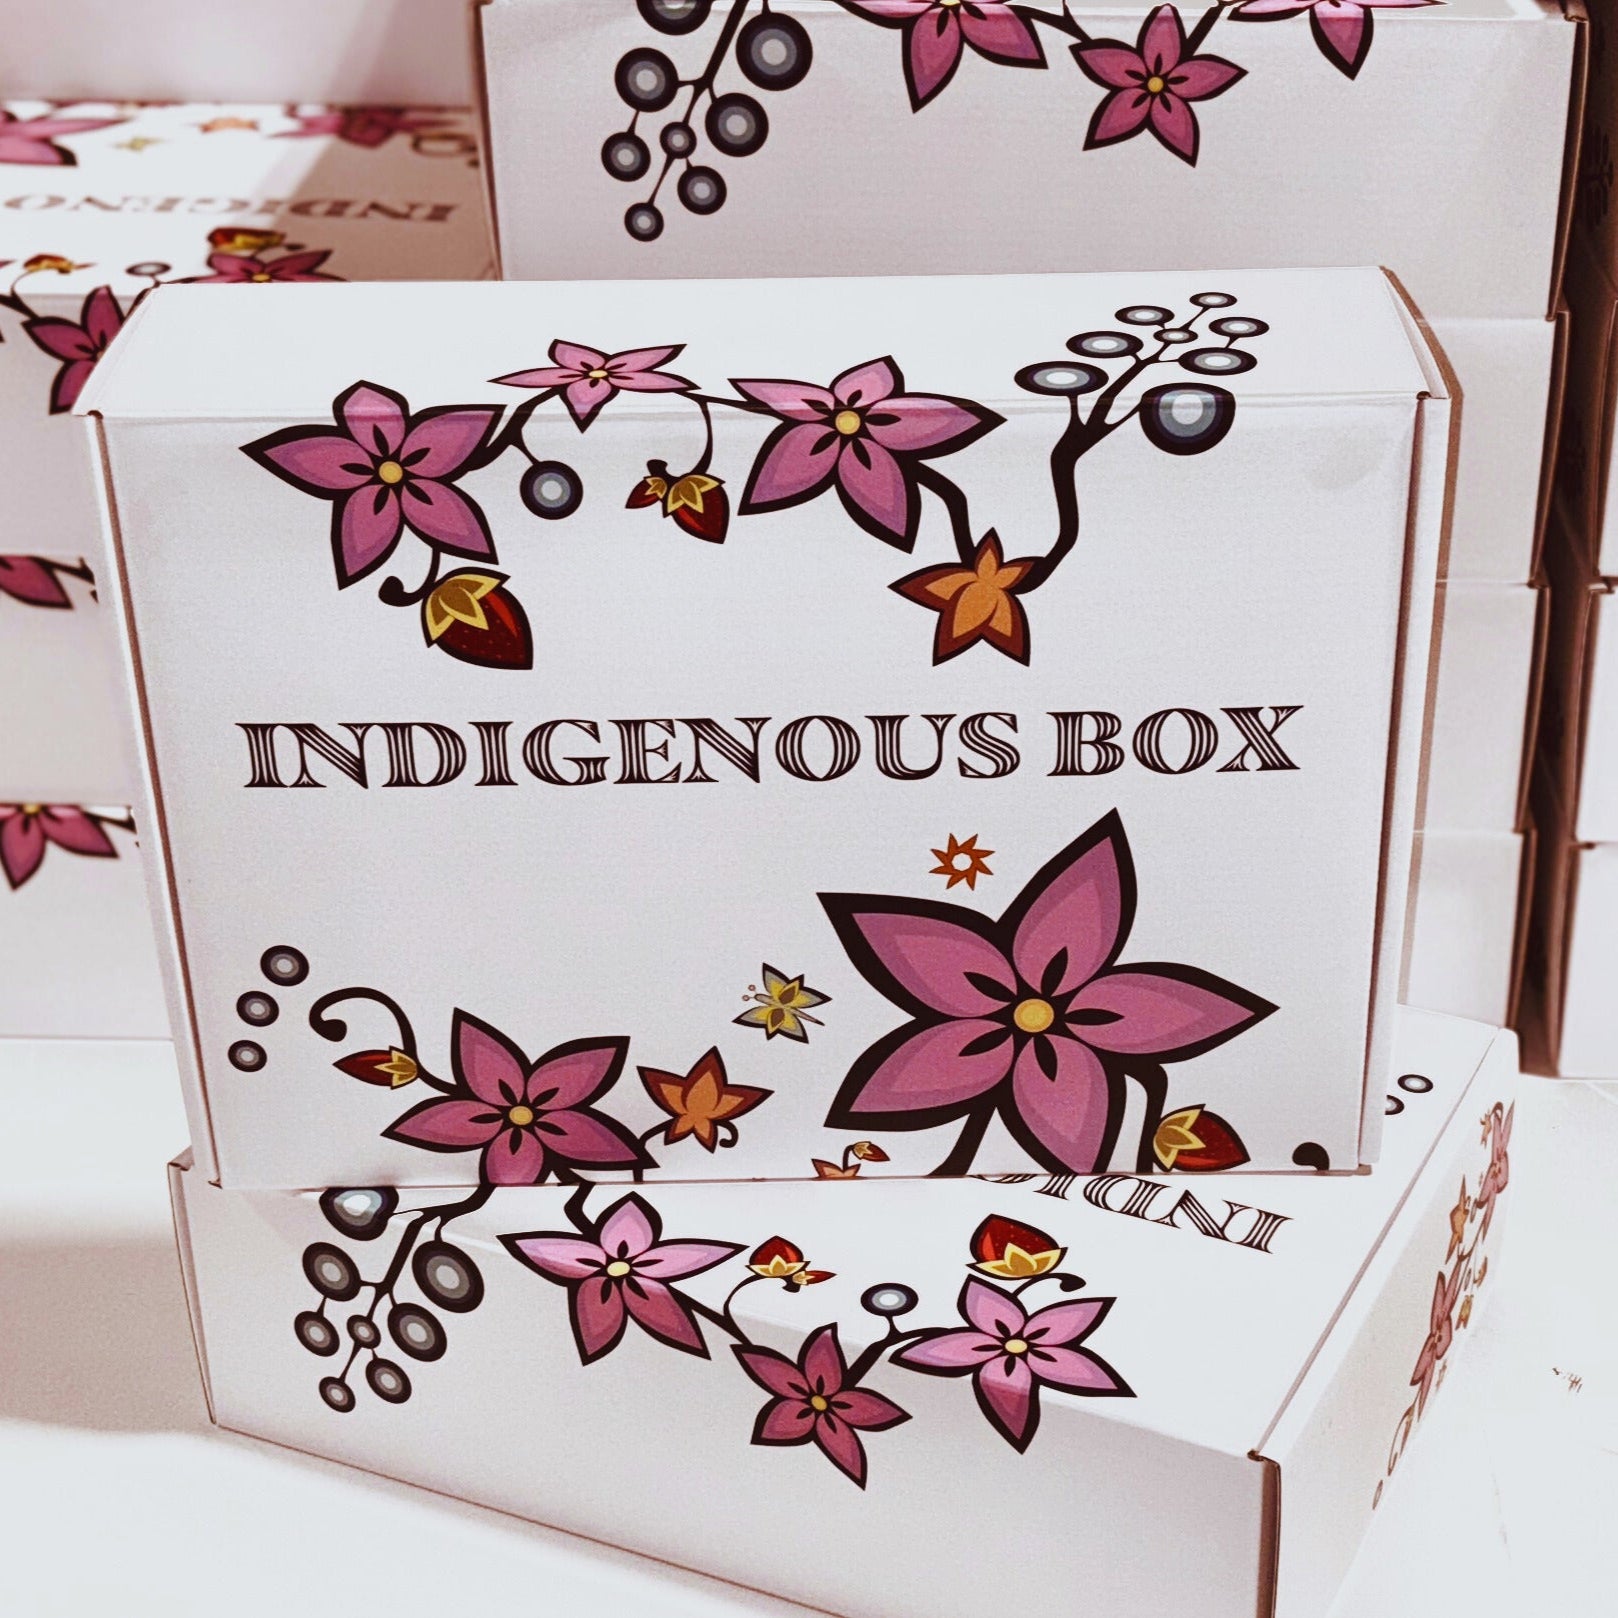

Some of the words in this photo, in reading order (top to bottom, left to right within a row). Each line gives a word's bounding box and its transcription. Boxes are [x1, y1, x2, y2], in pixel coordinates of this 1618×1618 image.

[235, 712, 1020, 789] INDIGENOUS
[1047, 705, 1304, 776] BOX
[968, 1173, 1293, 1254] INDI
